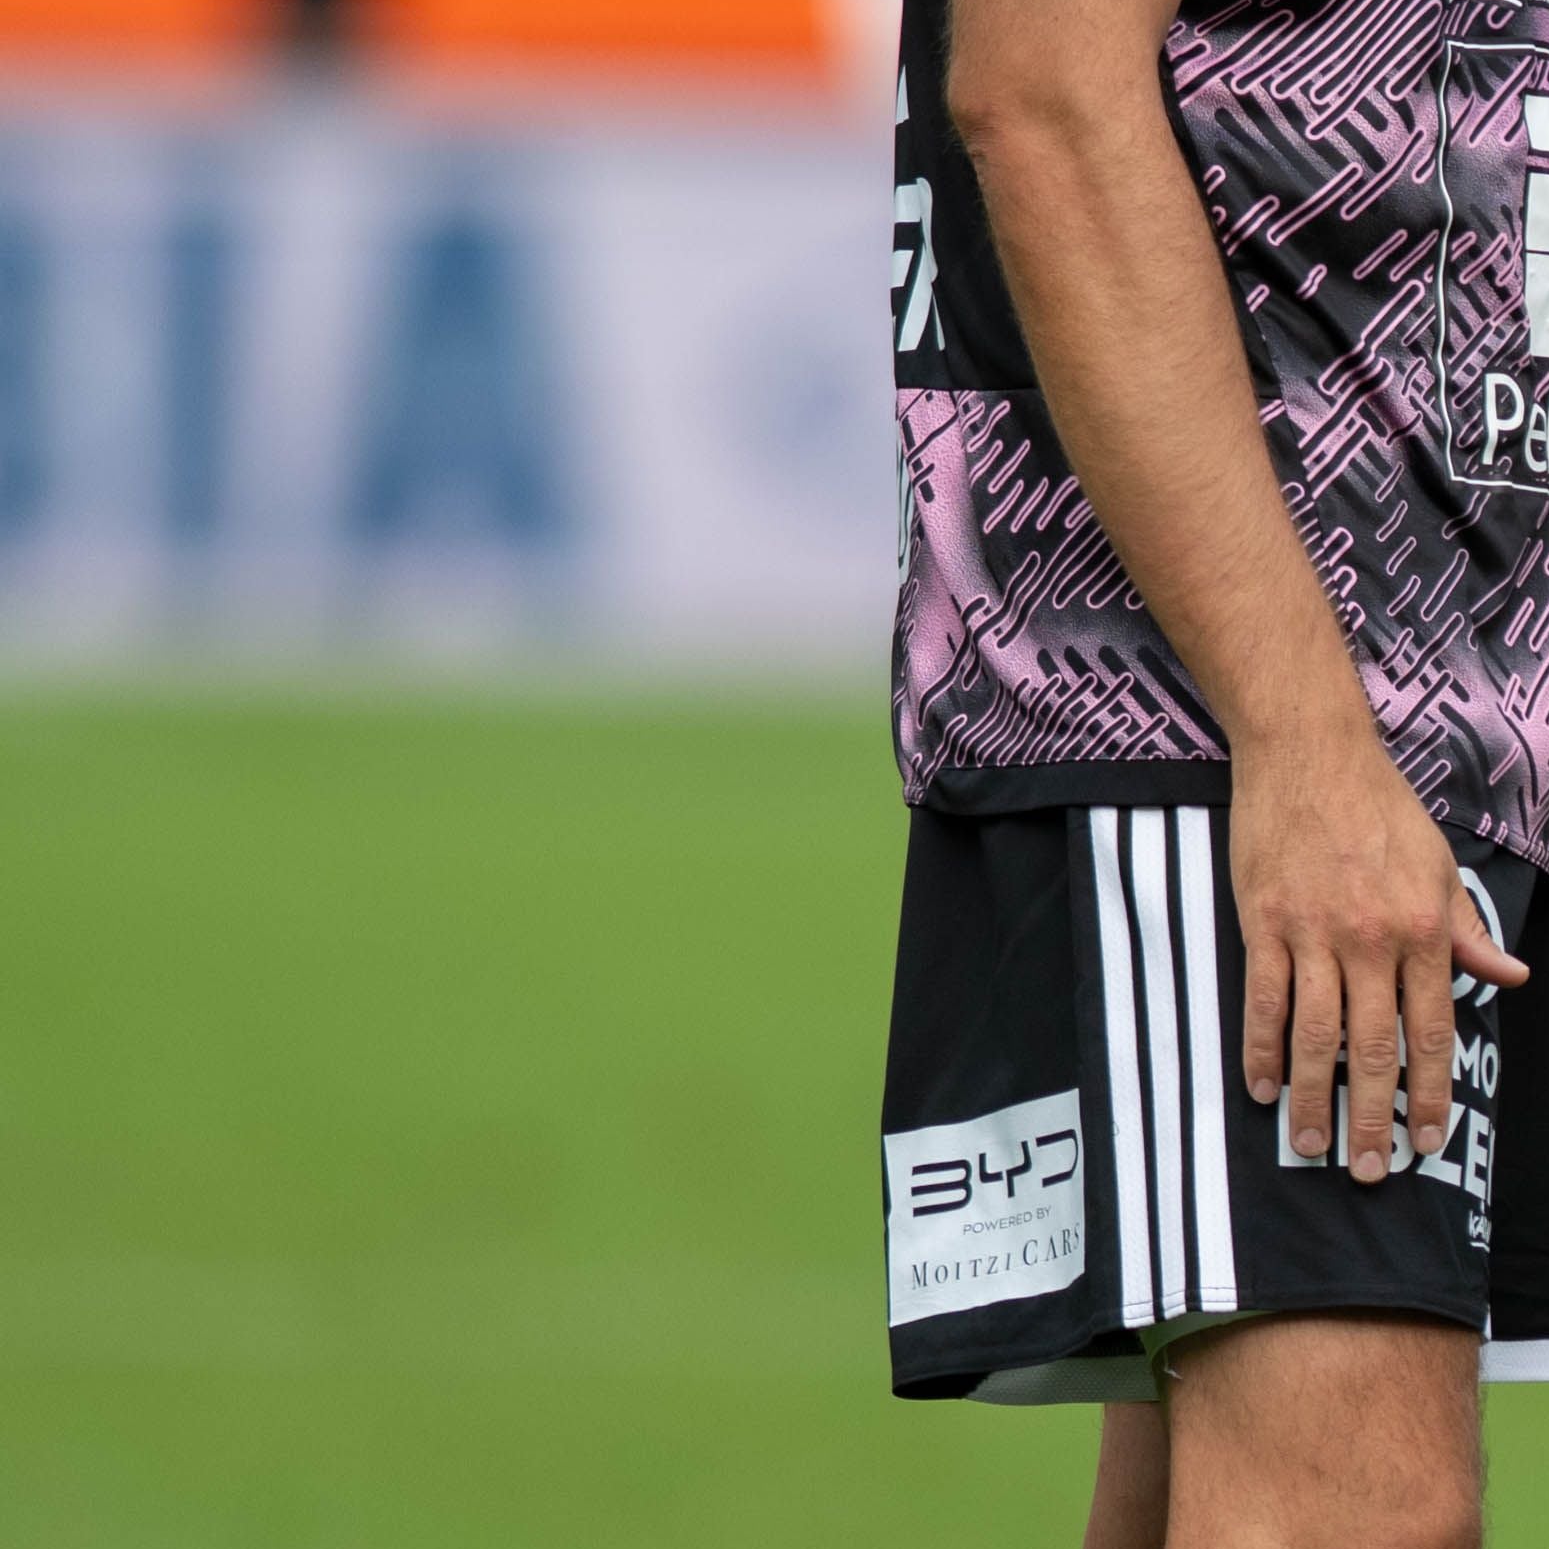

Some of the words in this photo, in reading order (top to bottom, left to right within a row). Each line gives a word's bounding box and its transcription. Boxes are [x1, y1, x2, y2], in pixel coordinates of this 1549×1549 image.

[911, 1128, 1079, 1218] BYD
[963, 1214, 1033, 1235] POWERED
[1037, 1206, 1052, 1221] BY
[1022, 1222, 1081, 1266] CARS
